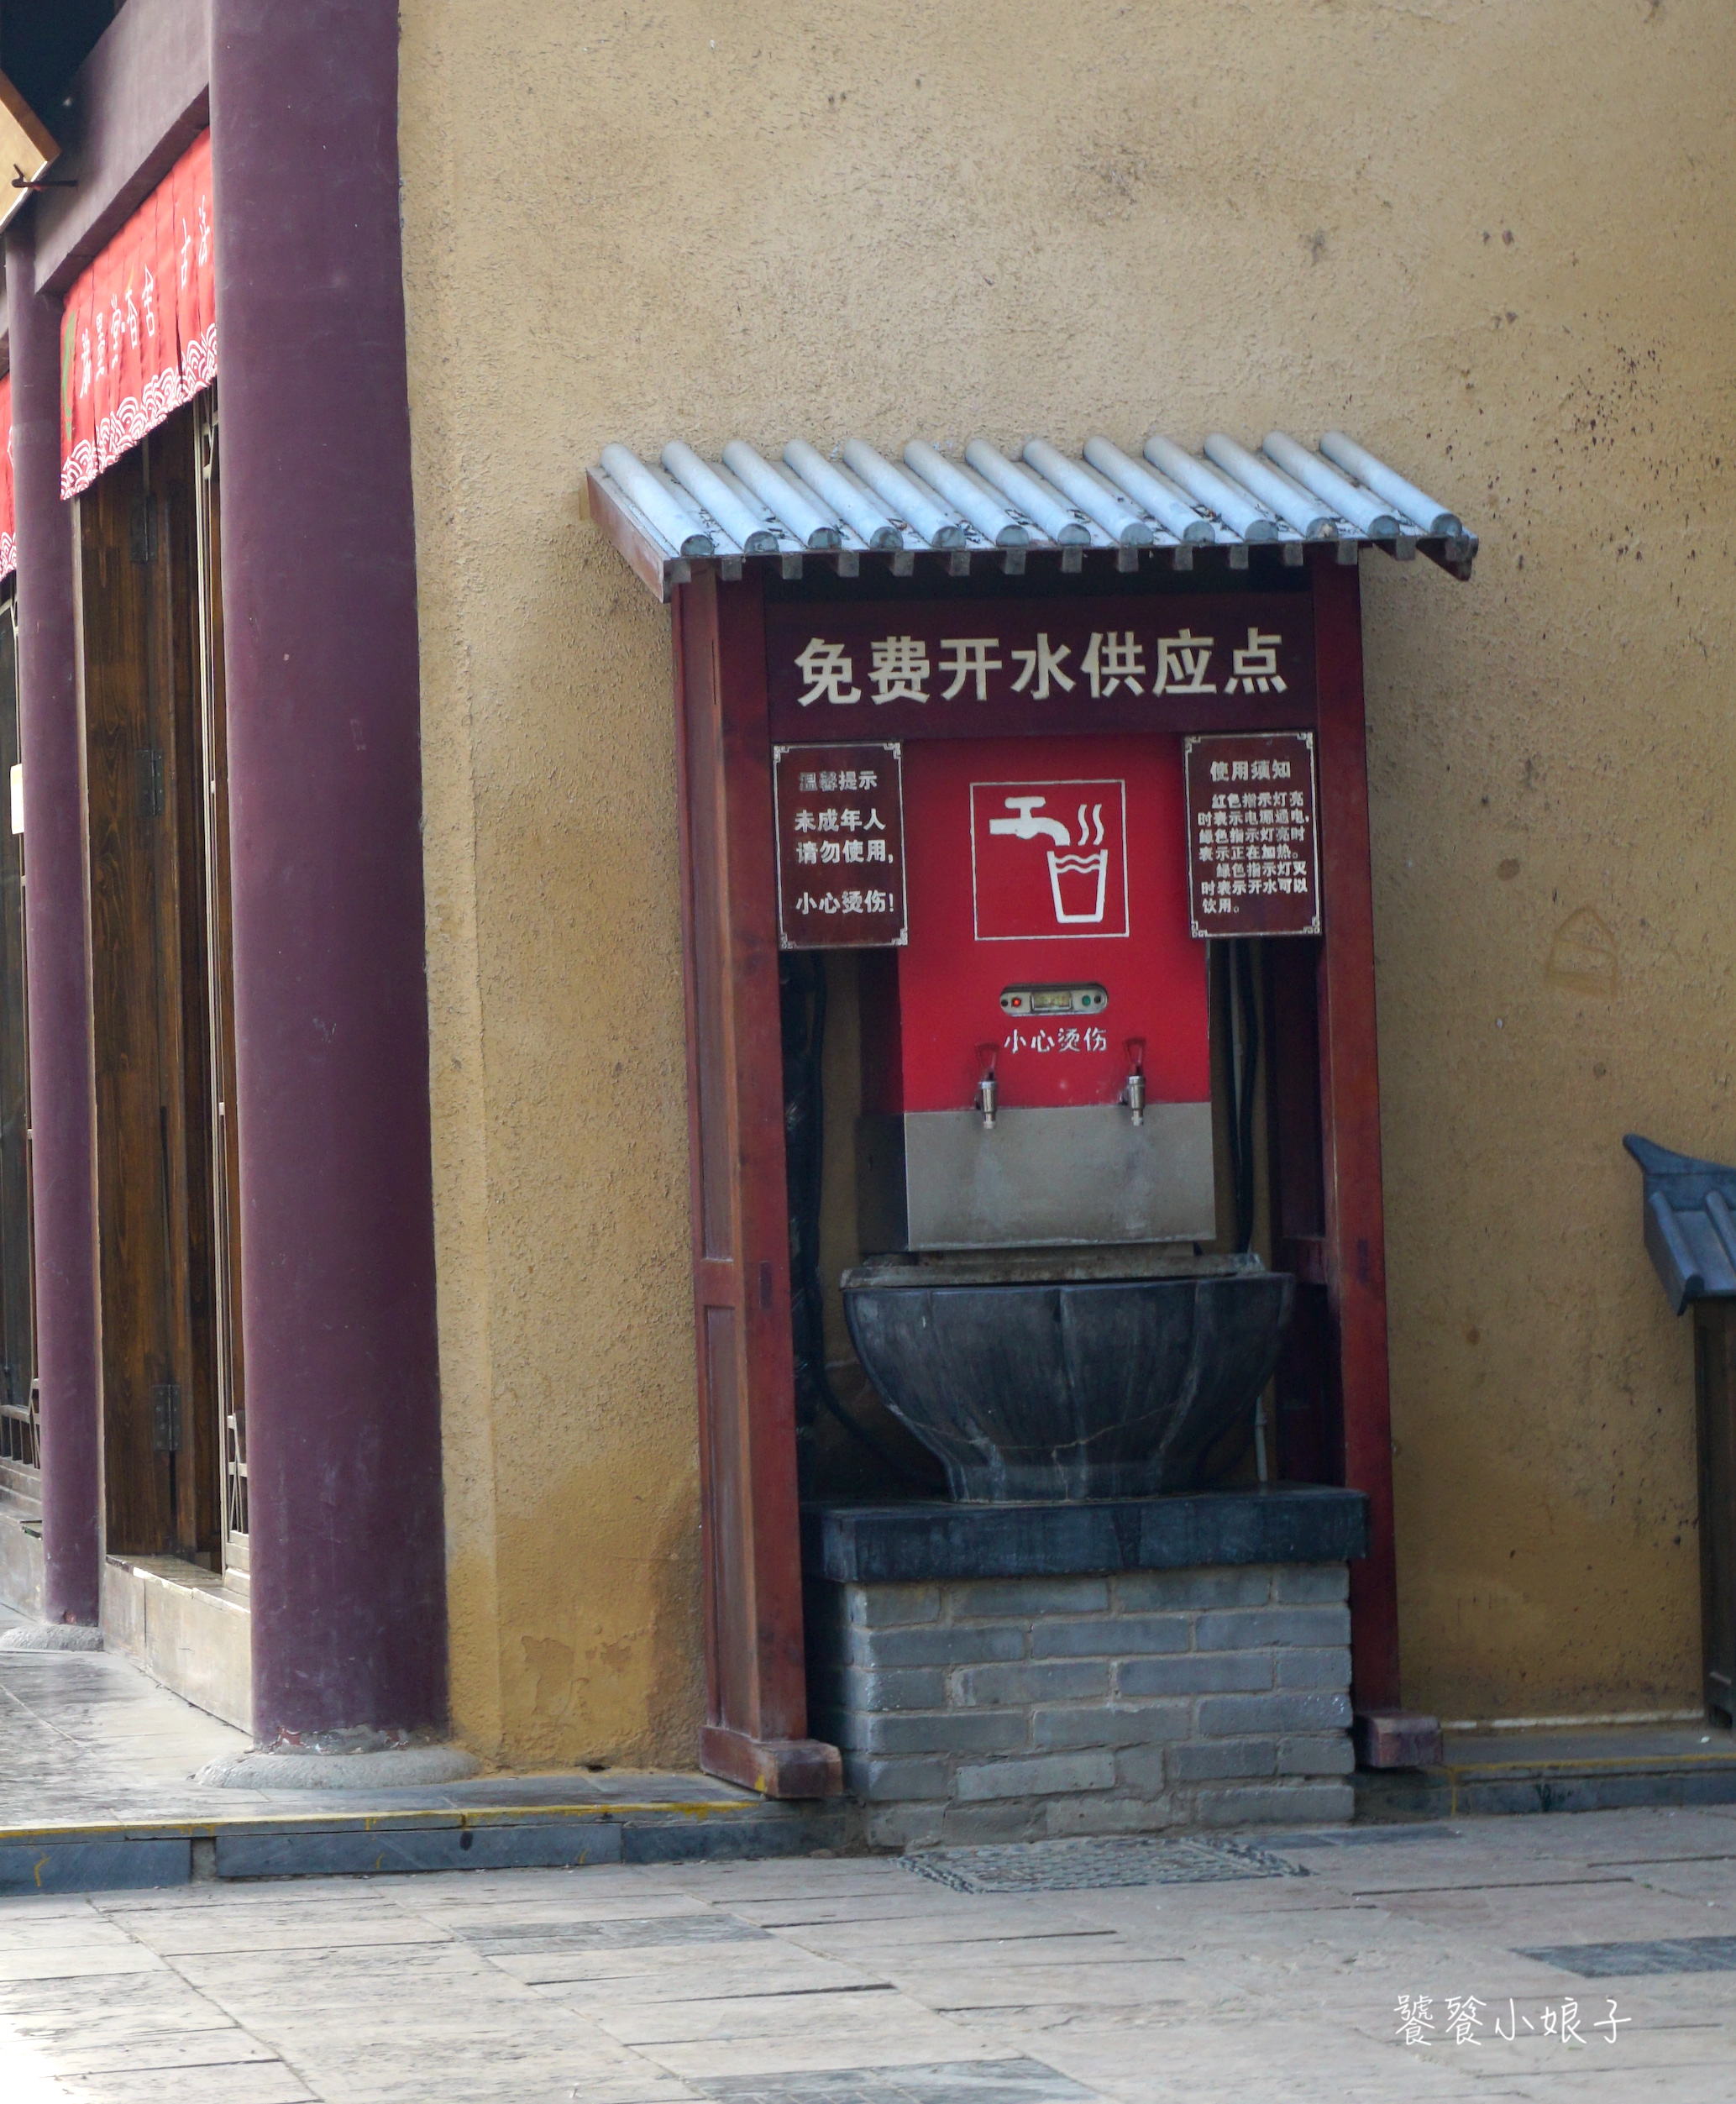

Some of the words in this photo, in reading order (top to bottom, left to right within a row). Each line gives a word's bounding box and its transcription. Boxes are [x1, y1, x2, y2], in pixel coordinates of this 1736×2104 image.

[794, 627, 1288, 707] 免费开水供应点
[1209, 758, 1292, 782] 使用须知
[799, 769, 878, 792] 温馨提示
[1211, 790, 1304, 809] 红色指示灯亮
[795, 808, 886, 833] 未成年人
[1198, 826, 1306, 845] 绿色指示灯亮时
[1198, 842, 1298, 862] 表示正在加热。
[1215, 860, 1308, 879] 绿色指示灯灭
[1201, 877, 1309, 896] 时表示开水可以
[1202, 897, 1240, 914] 饮用。
[1004, 1026, 1108, 1054] 小心烫伤
